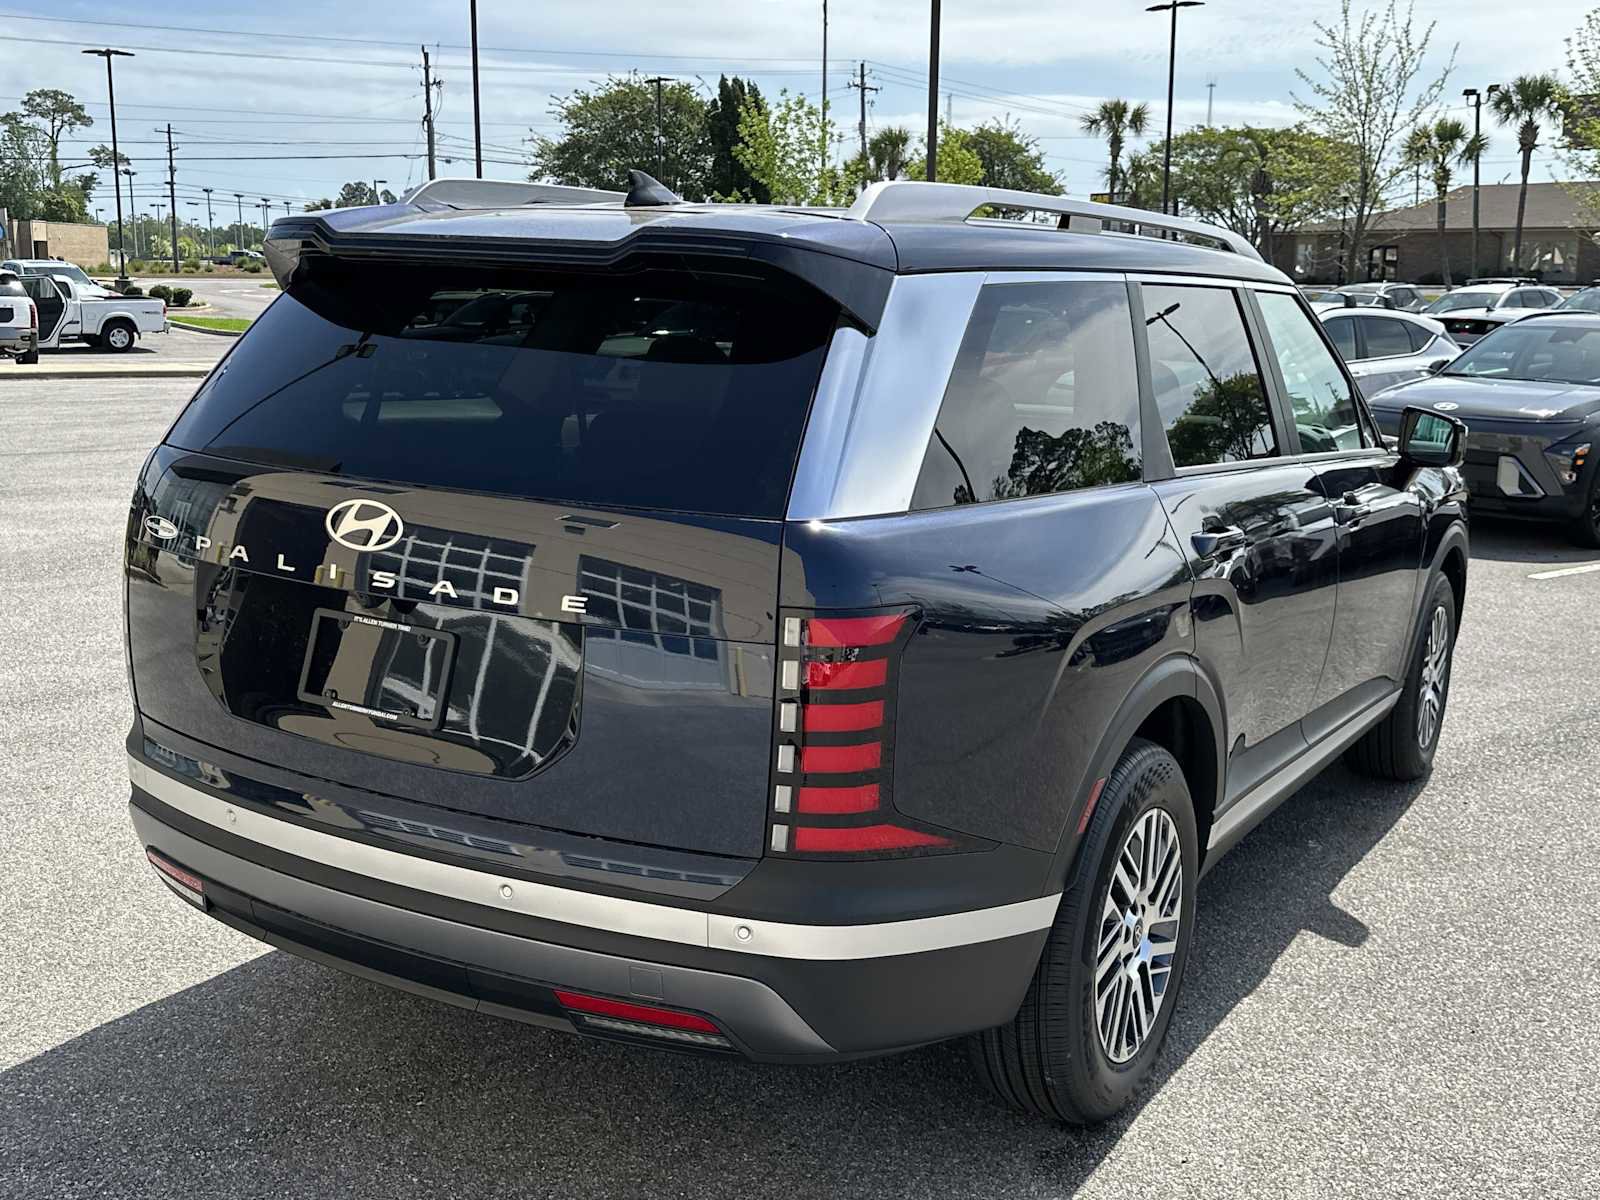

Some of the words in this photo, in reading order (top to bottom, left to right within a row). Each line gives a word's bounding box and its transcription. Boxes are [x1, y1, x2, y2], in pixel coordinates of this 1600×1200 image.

[196, 535, 589, 614] PALISADE
[362, 617, 378, 627] ALLEN
[378, 620, 398, 630] TUR
[331, 701, 398, 720] ALLENTUYUNDAI.COM
